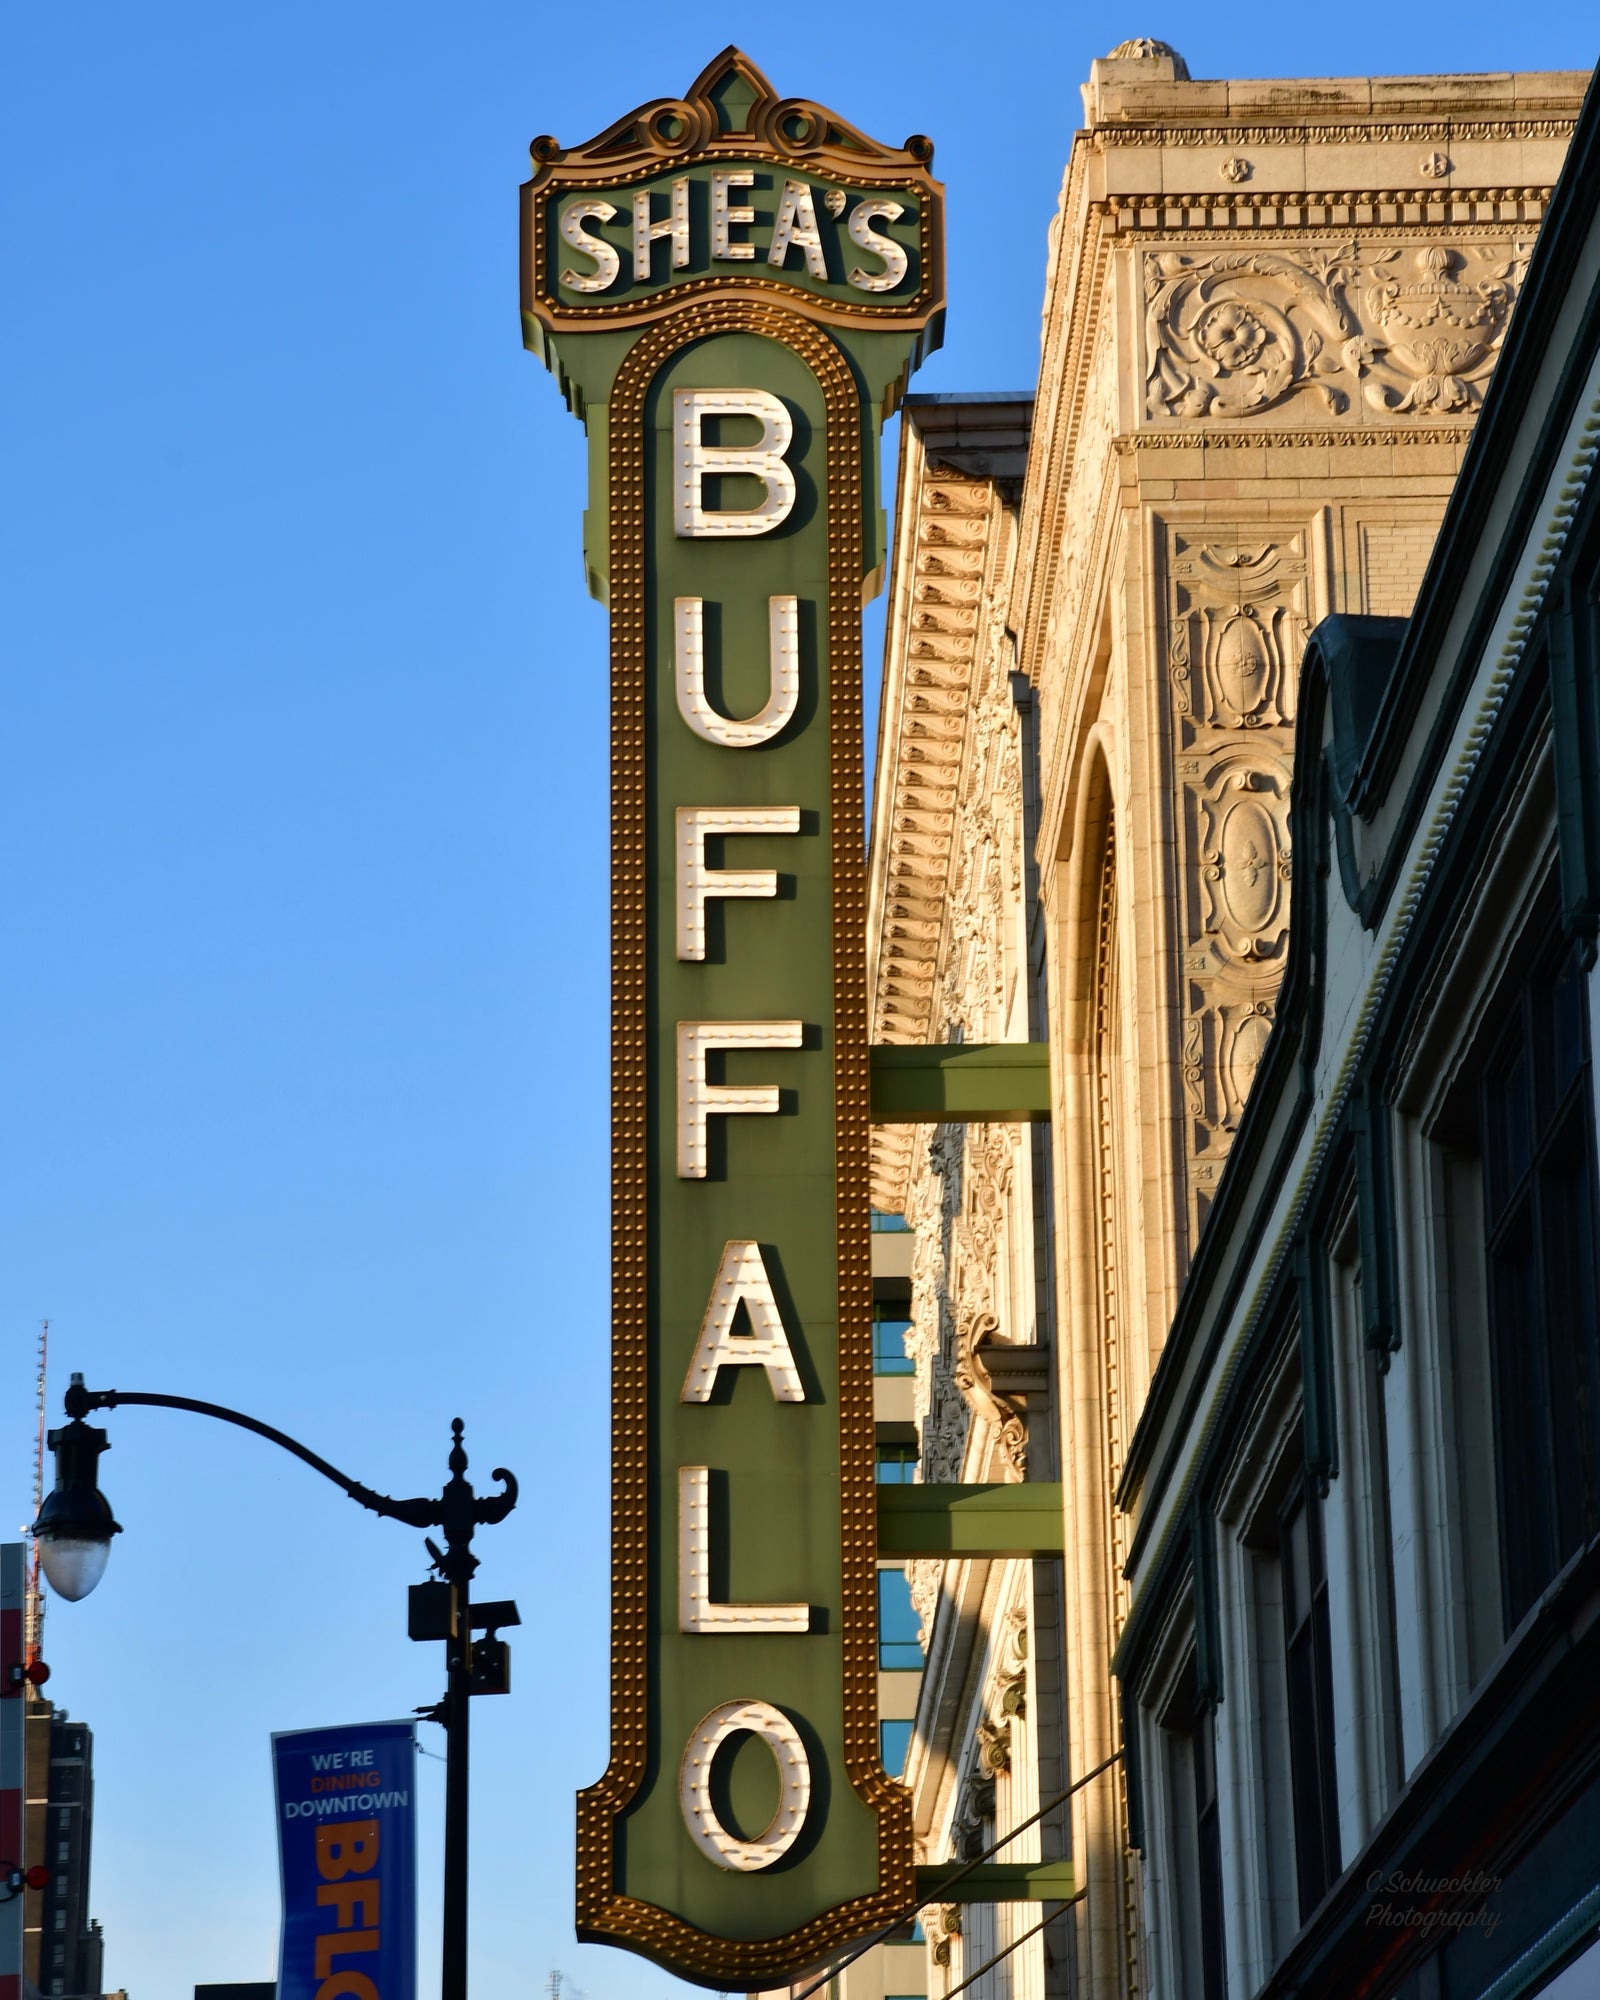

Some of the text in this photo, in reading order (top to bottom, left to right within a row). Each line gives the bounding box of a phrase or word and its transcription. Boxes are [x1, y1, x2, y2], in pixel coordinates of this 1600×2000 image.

[559, 169, 909, 294] SHEA'S
[672, 387, 811, 1873] BUFFALO
[285, 1790, 408, 1819] DOWNTOWN
[310, 1771, 381, 1793] DINING
